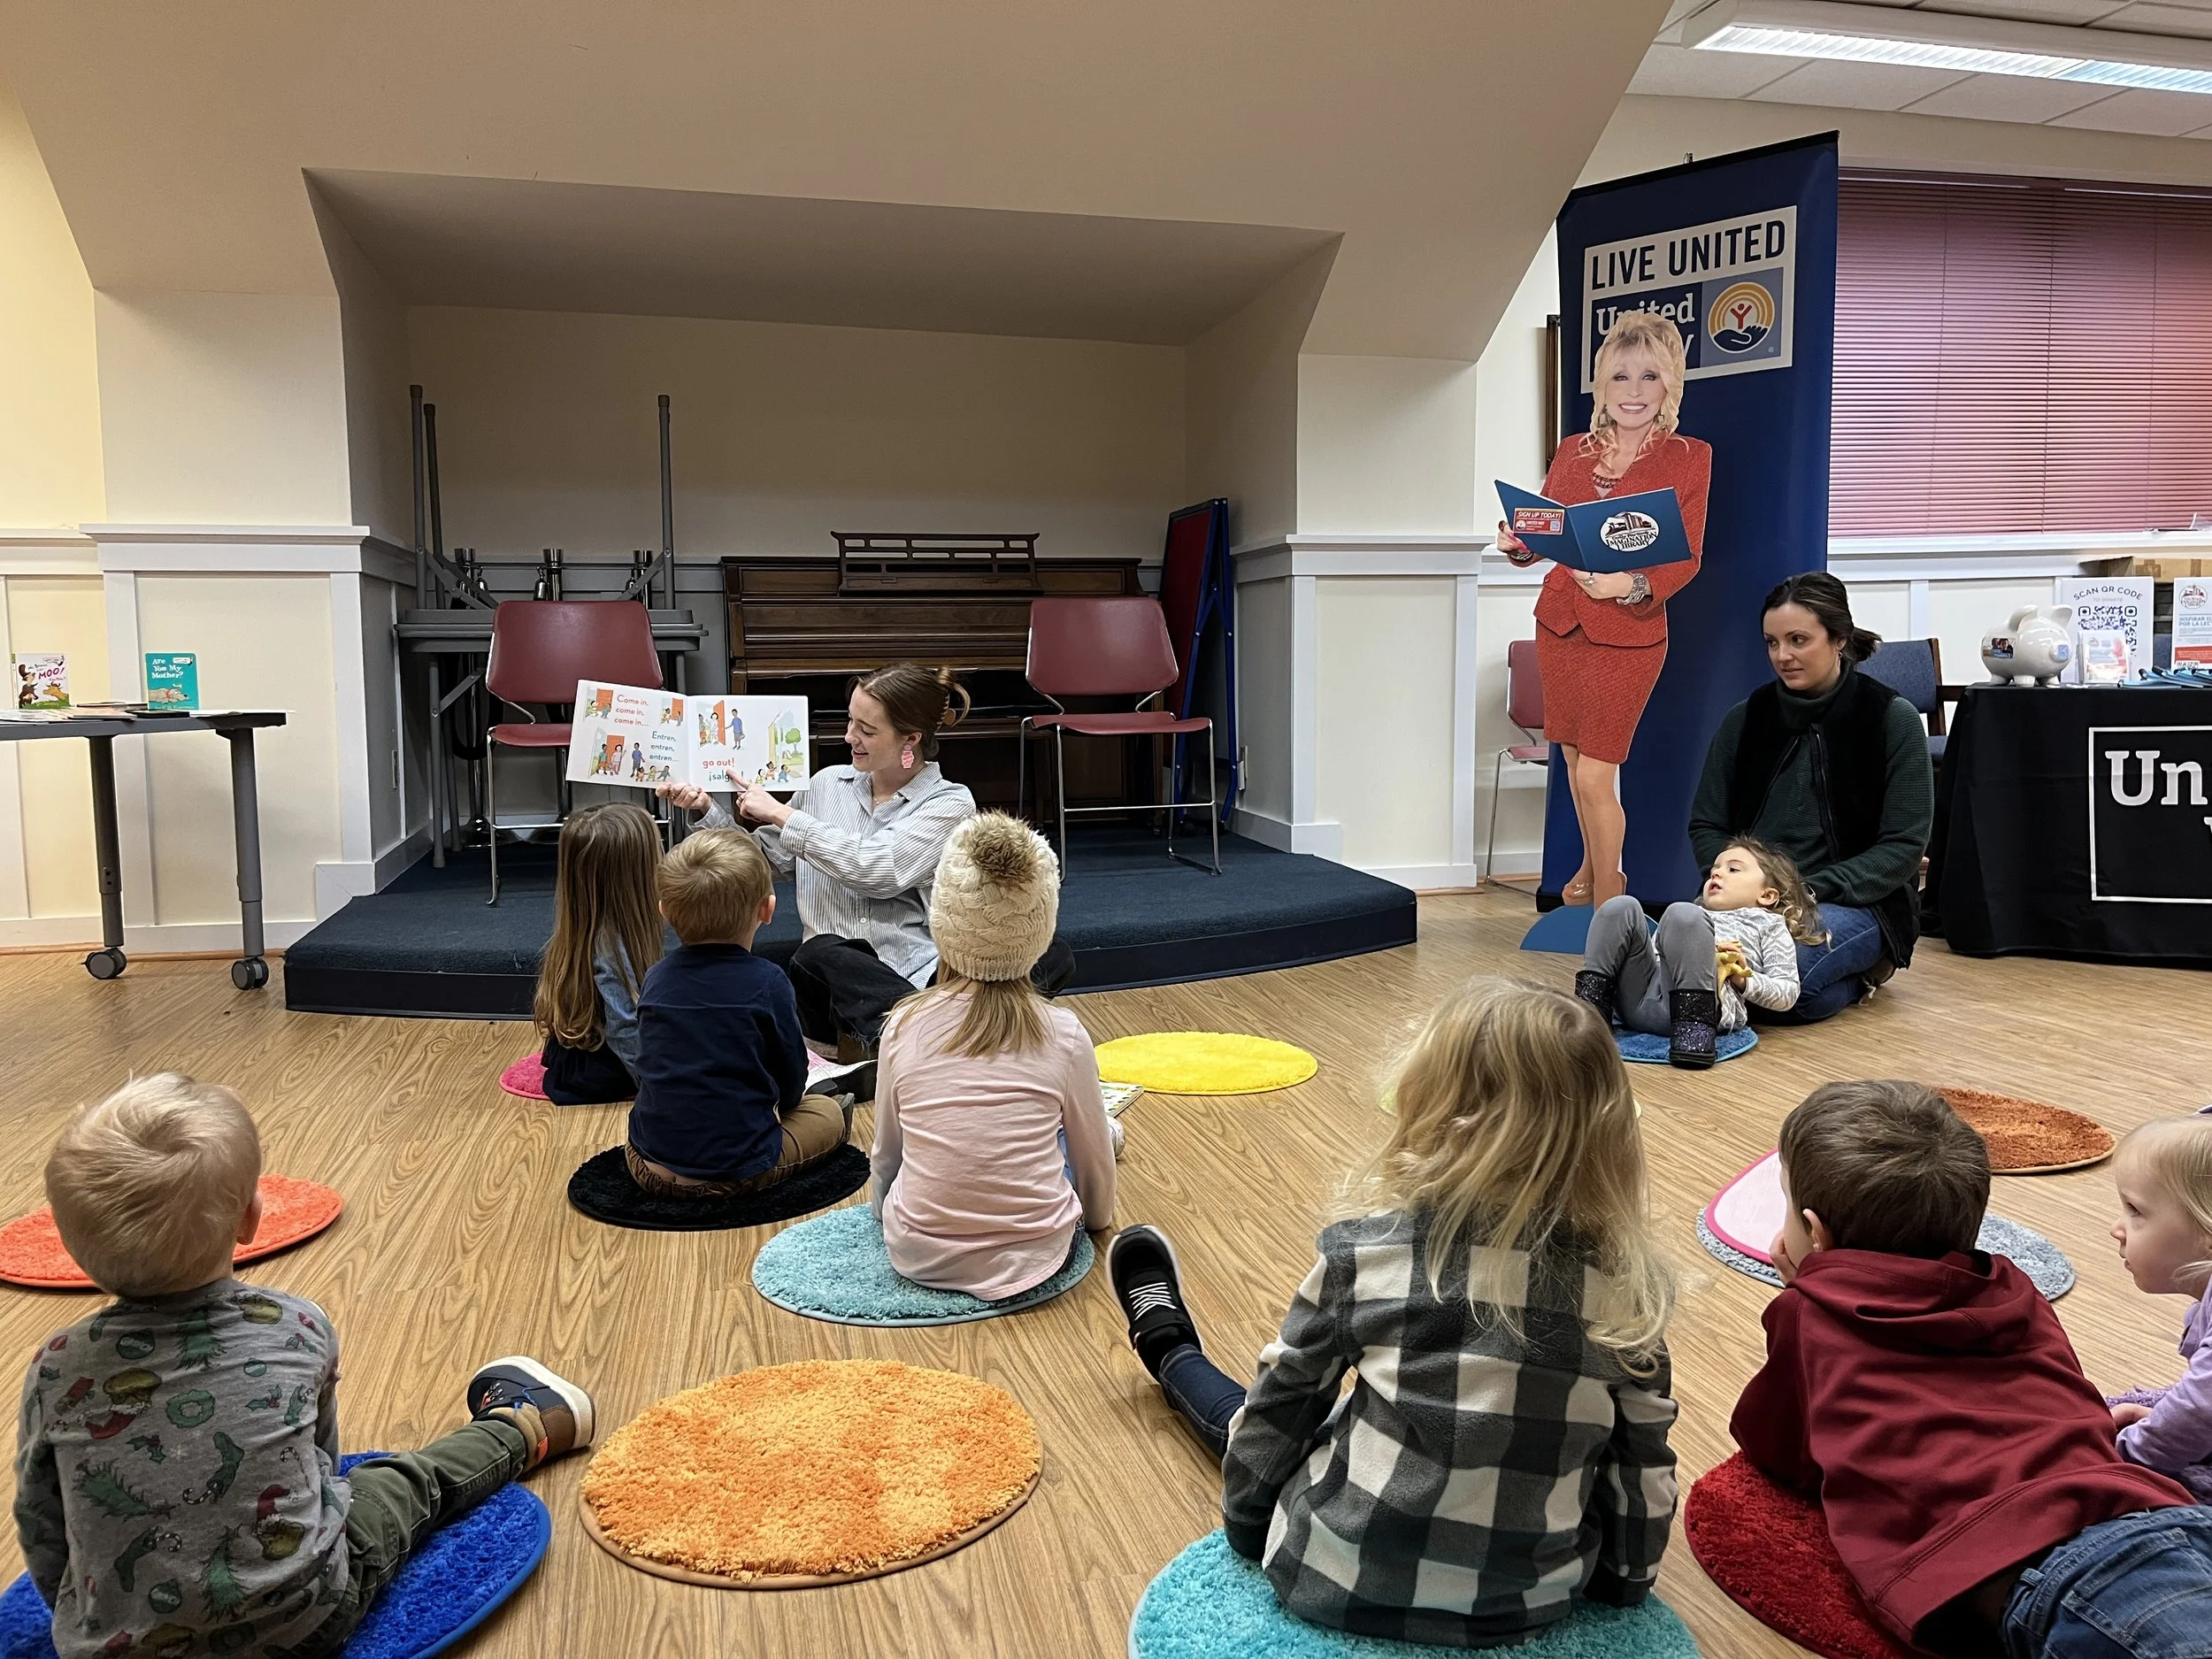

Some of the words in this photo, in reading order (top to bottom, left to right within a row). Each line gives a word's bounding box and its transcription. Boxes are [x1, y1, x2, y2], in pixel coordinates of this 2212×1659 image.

[1592, 245, 1655, 290] LIVE
[1669, 220, 1786, 276] UNITED
[1605, 531, 1657, 547] IMAGINATION
[2073, 587, 2099, 600] SCAN
[2117, 587, 2143, 600] CODE
[38, 667, 65, 680] MOO!
[617, 694, 639, 705] Come
[651, 731, 677, 741] Entren,
[703, 760, 714, 769] go
[717, 757, 734, 767] out!
